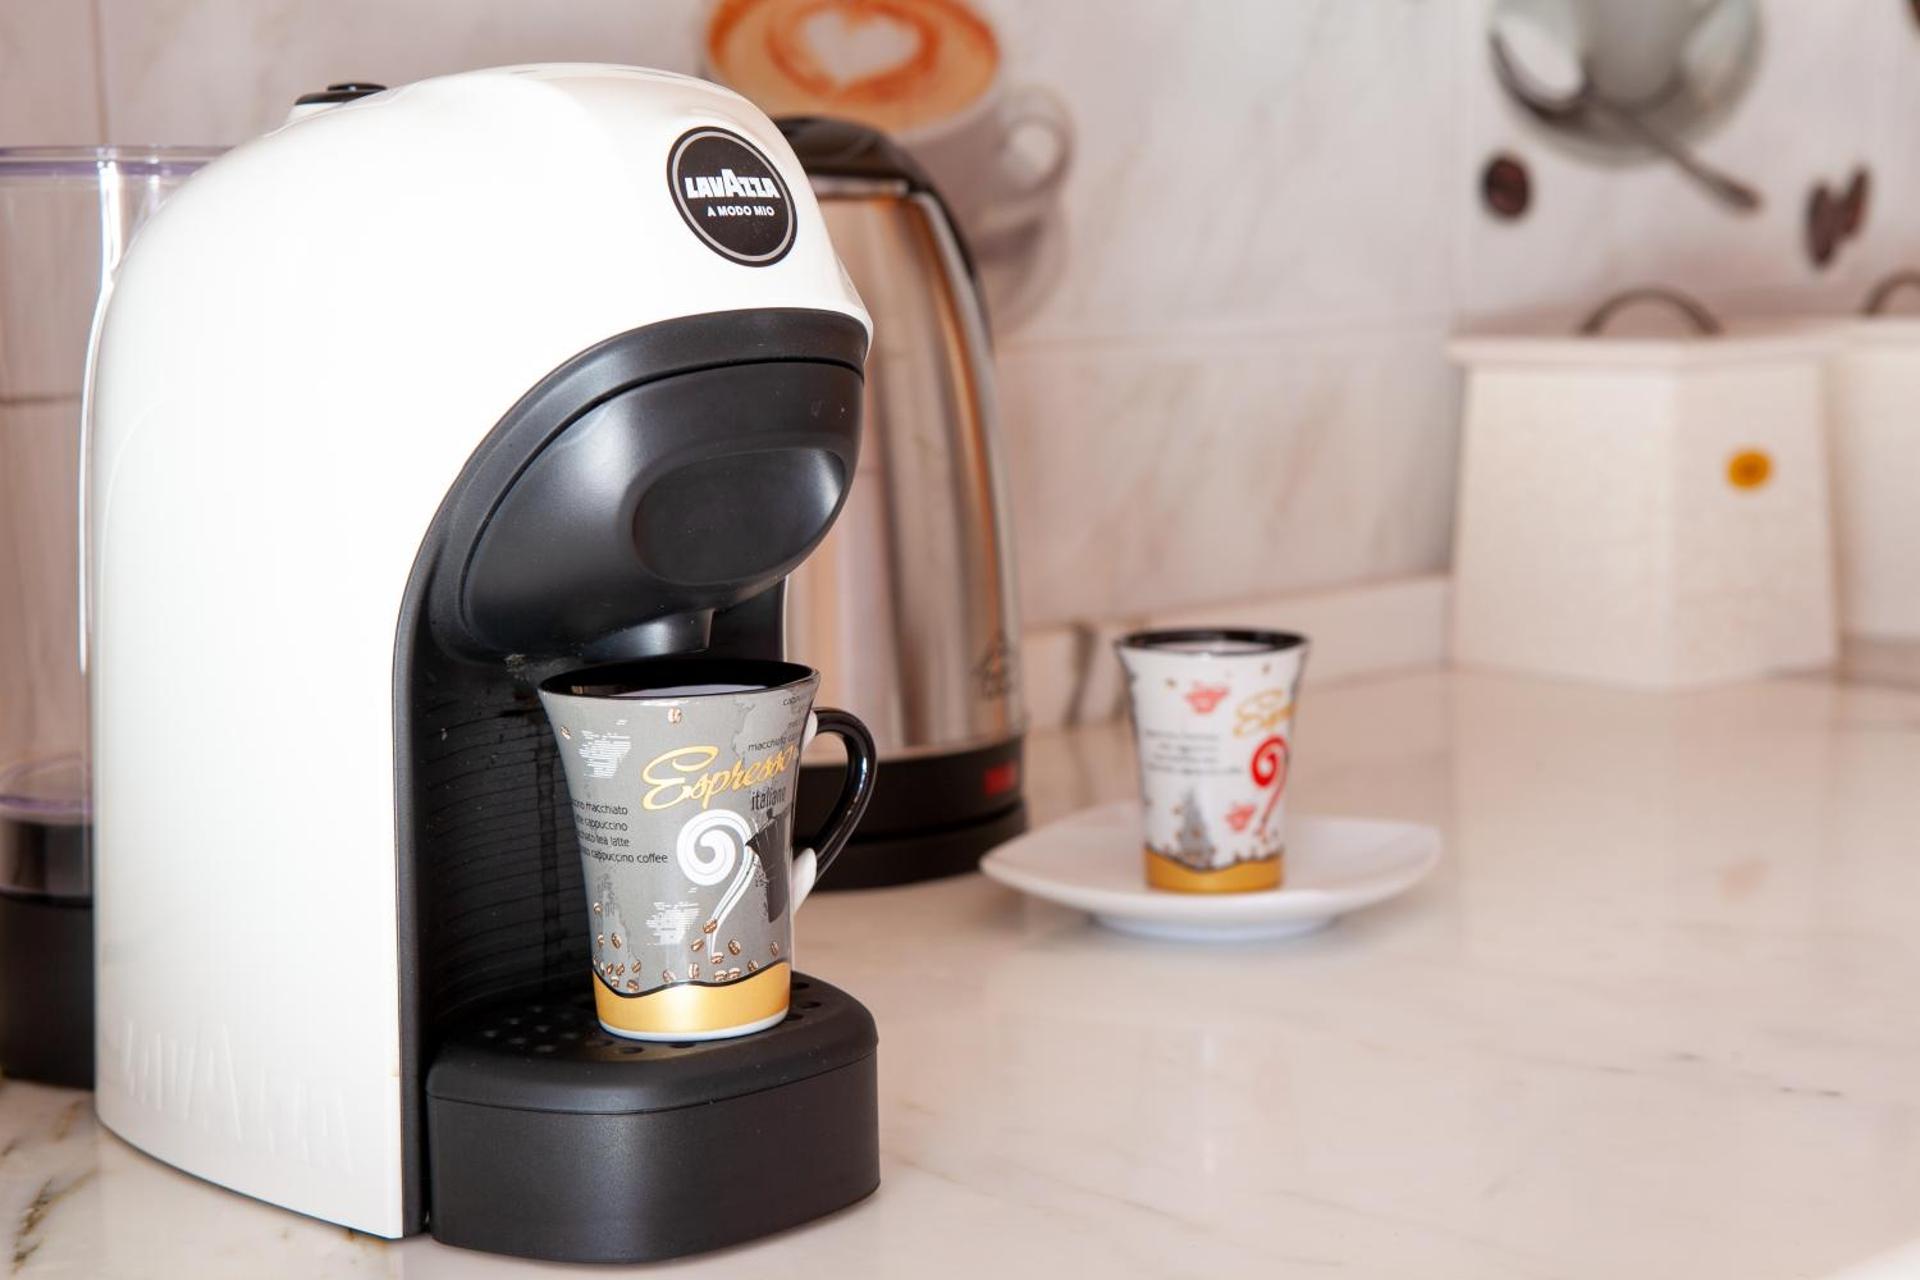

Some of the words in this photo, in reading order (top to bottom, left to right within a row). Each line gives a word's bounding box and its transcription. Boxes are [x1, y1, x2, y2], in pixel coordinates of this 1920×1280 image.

[684, 168, 781, 199] LAVAZZA
[707, 206, 716, 217] A
[717, 206, 752, 217] MODO
[754, 206, 776, 217] MIO
[641, 745, 797, 811] Espresso
[611, 833, 630, 847] latte
[591, 848, 634, 863] cappuccino
[637, 851, 669, 863] coffee
